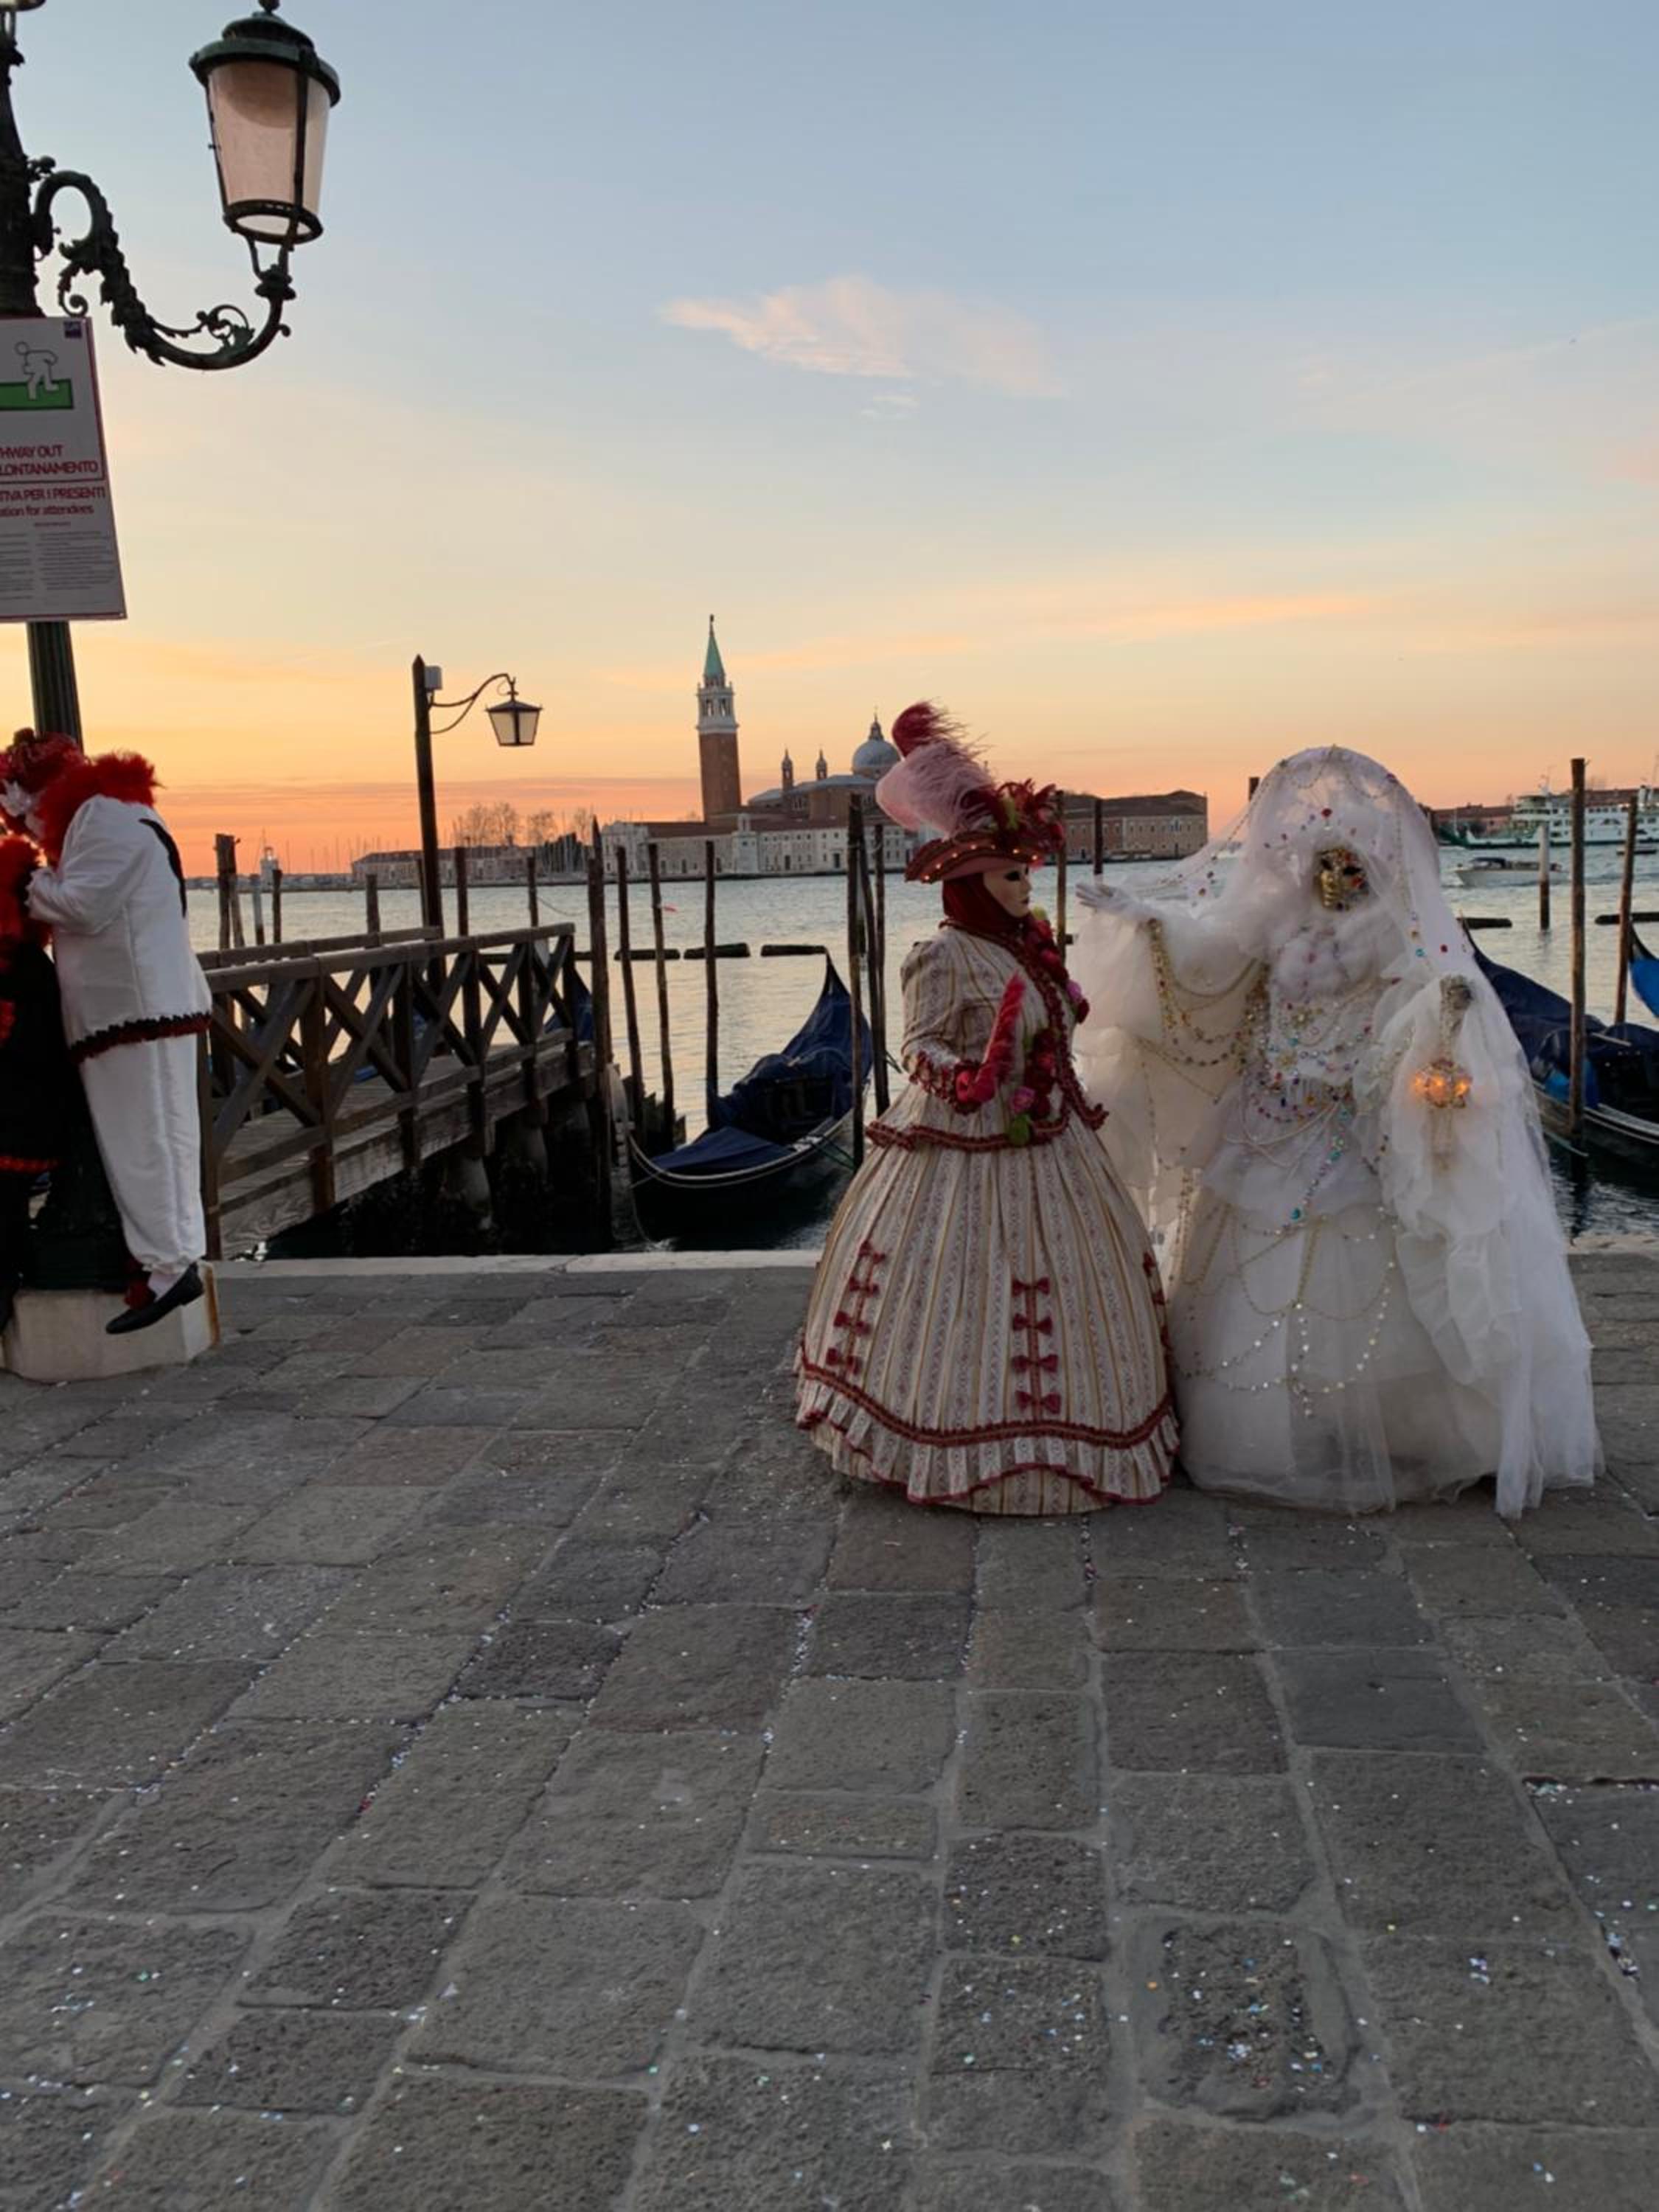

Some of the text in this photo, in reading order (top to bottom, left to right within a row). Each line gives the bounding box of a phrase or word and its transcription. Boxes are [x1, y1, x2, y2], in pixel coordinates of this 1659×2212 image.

[38, 445, 63, 458] OUT
[24, 489, 45, 500] PER
[52, 487, 105, 499] PRESENTI
[26, 504, 40, 515] for
